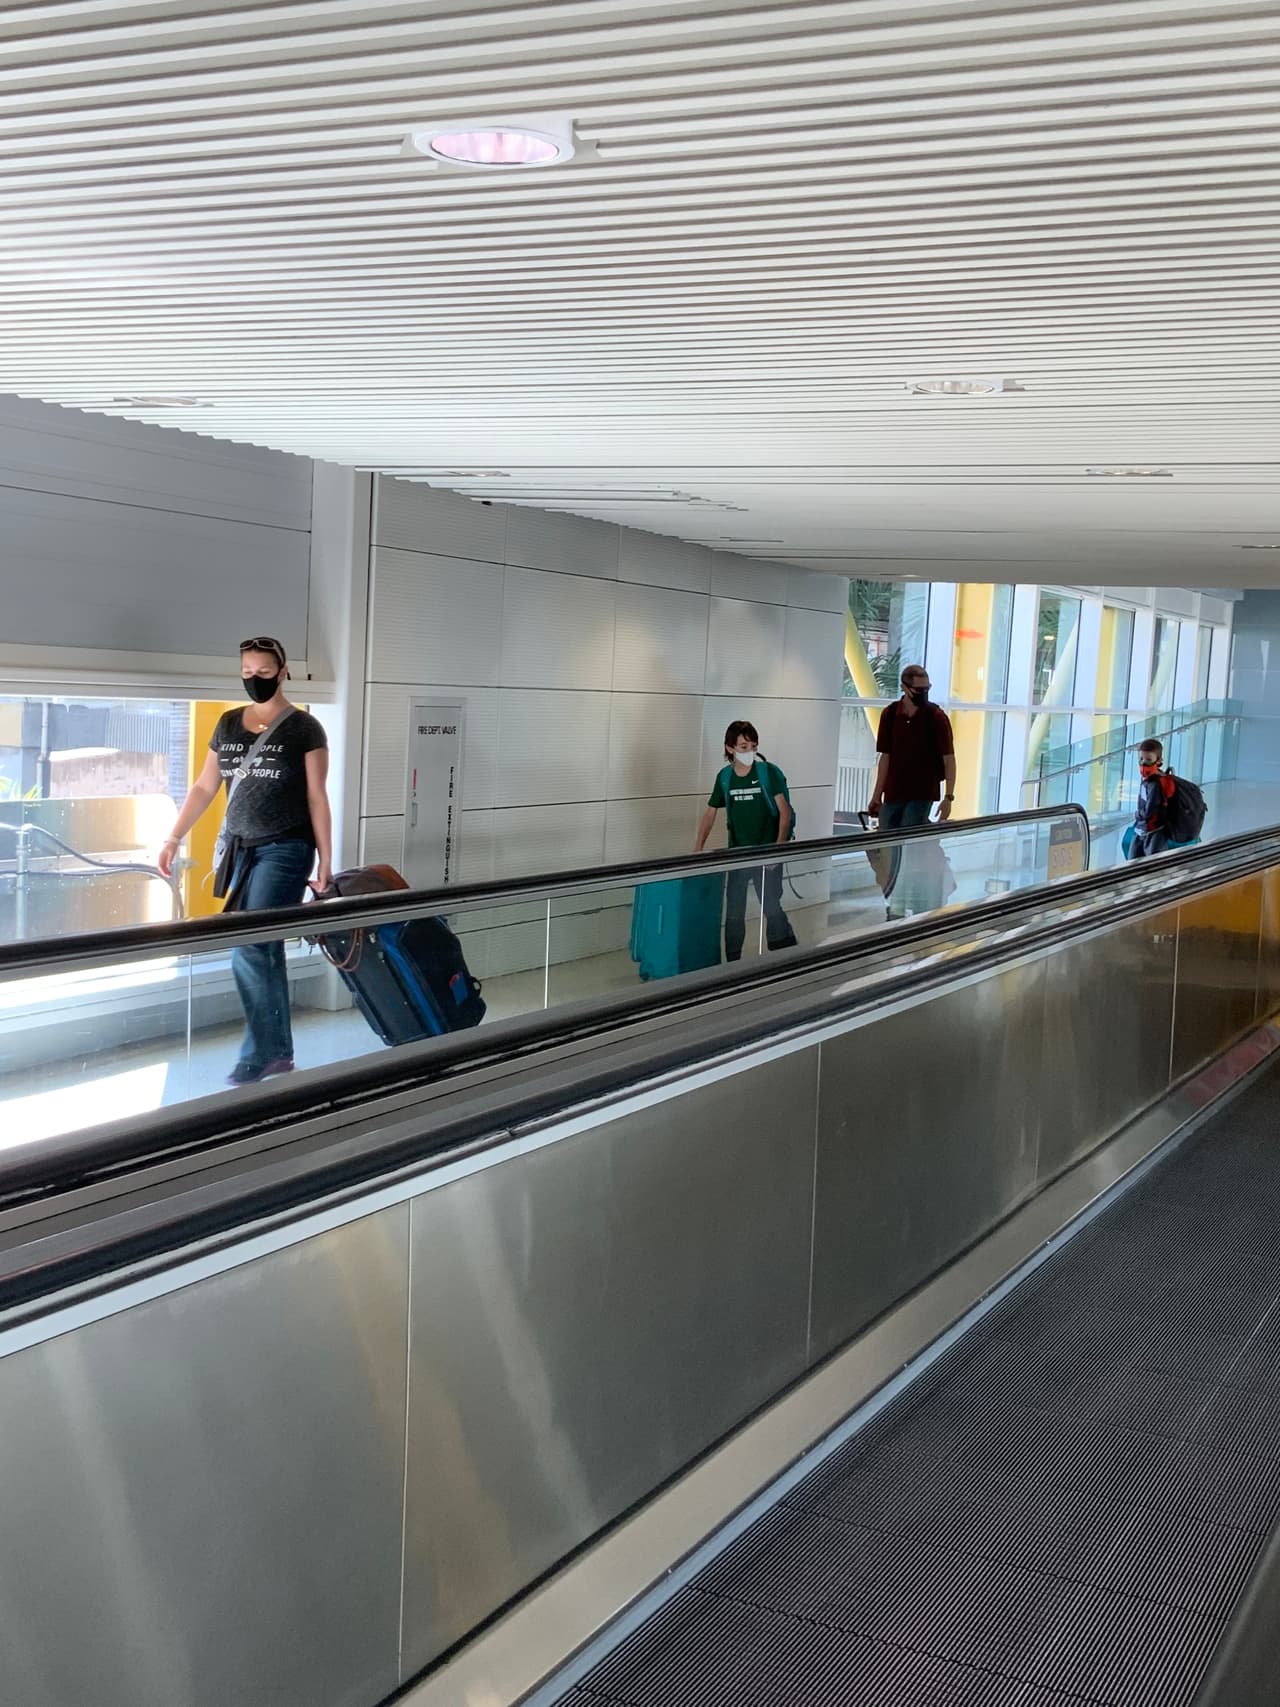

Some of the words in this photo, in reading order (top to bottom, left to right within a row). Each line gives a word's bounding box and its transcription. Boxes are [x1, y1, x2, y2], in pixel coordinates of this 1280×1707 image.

[221, 743, 244, 752] KIND
[249, 744, 284, 752] POPLE
[444, 805, 452, 883] EXTINGUISH
